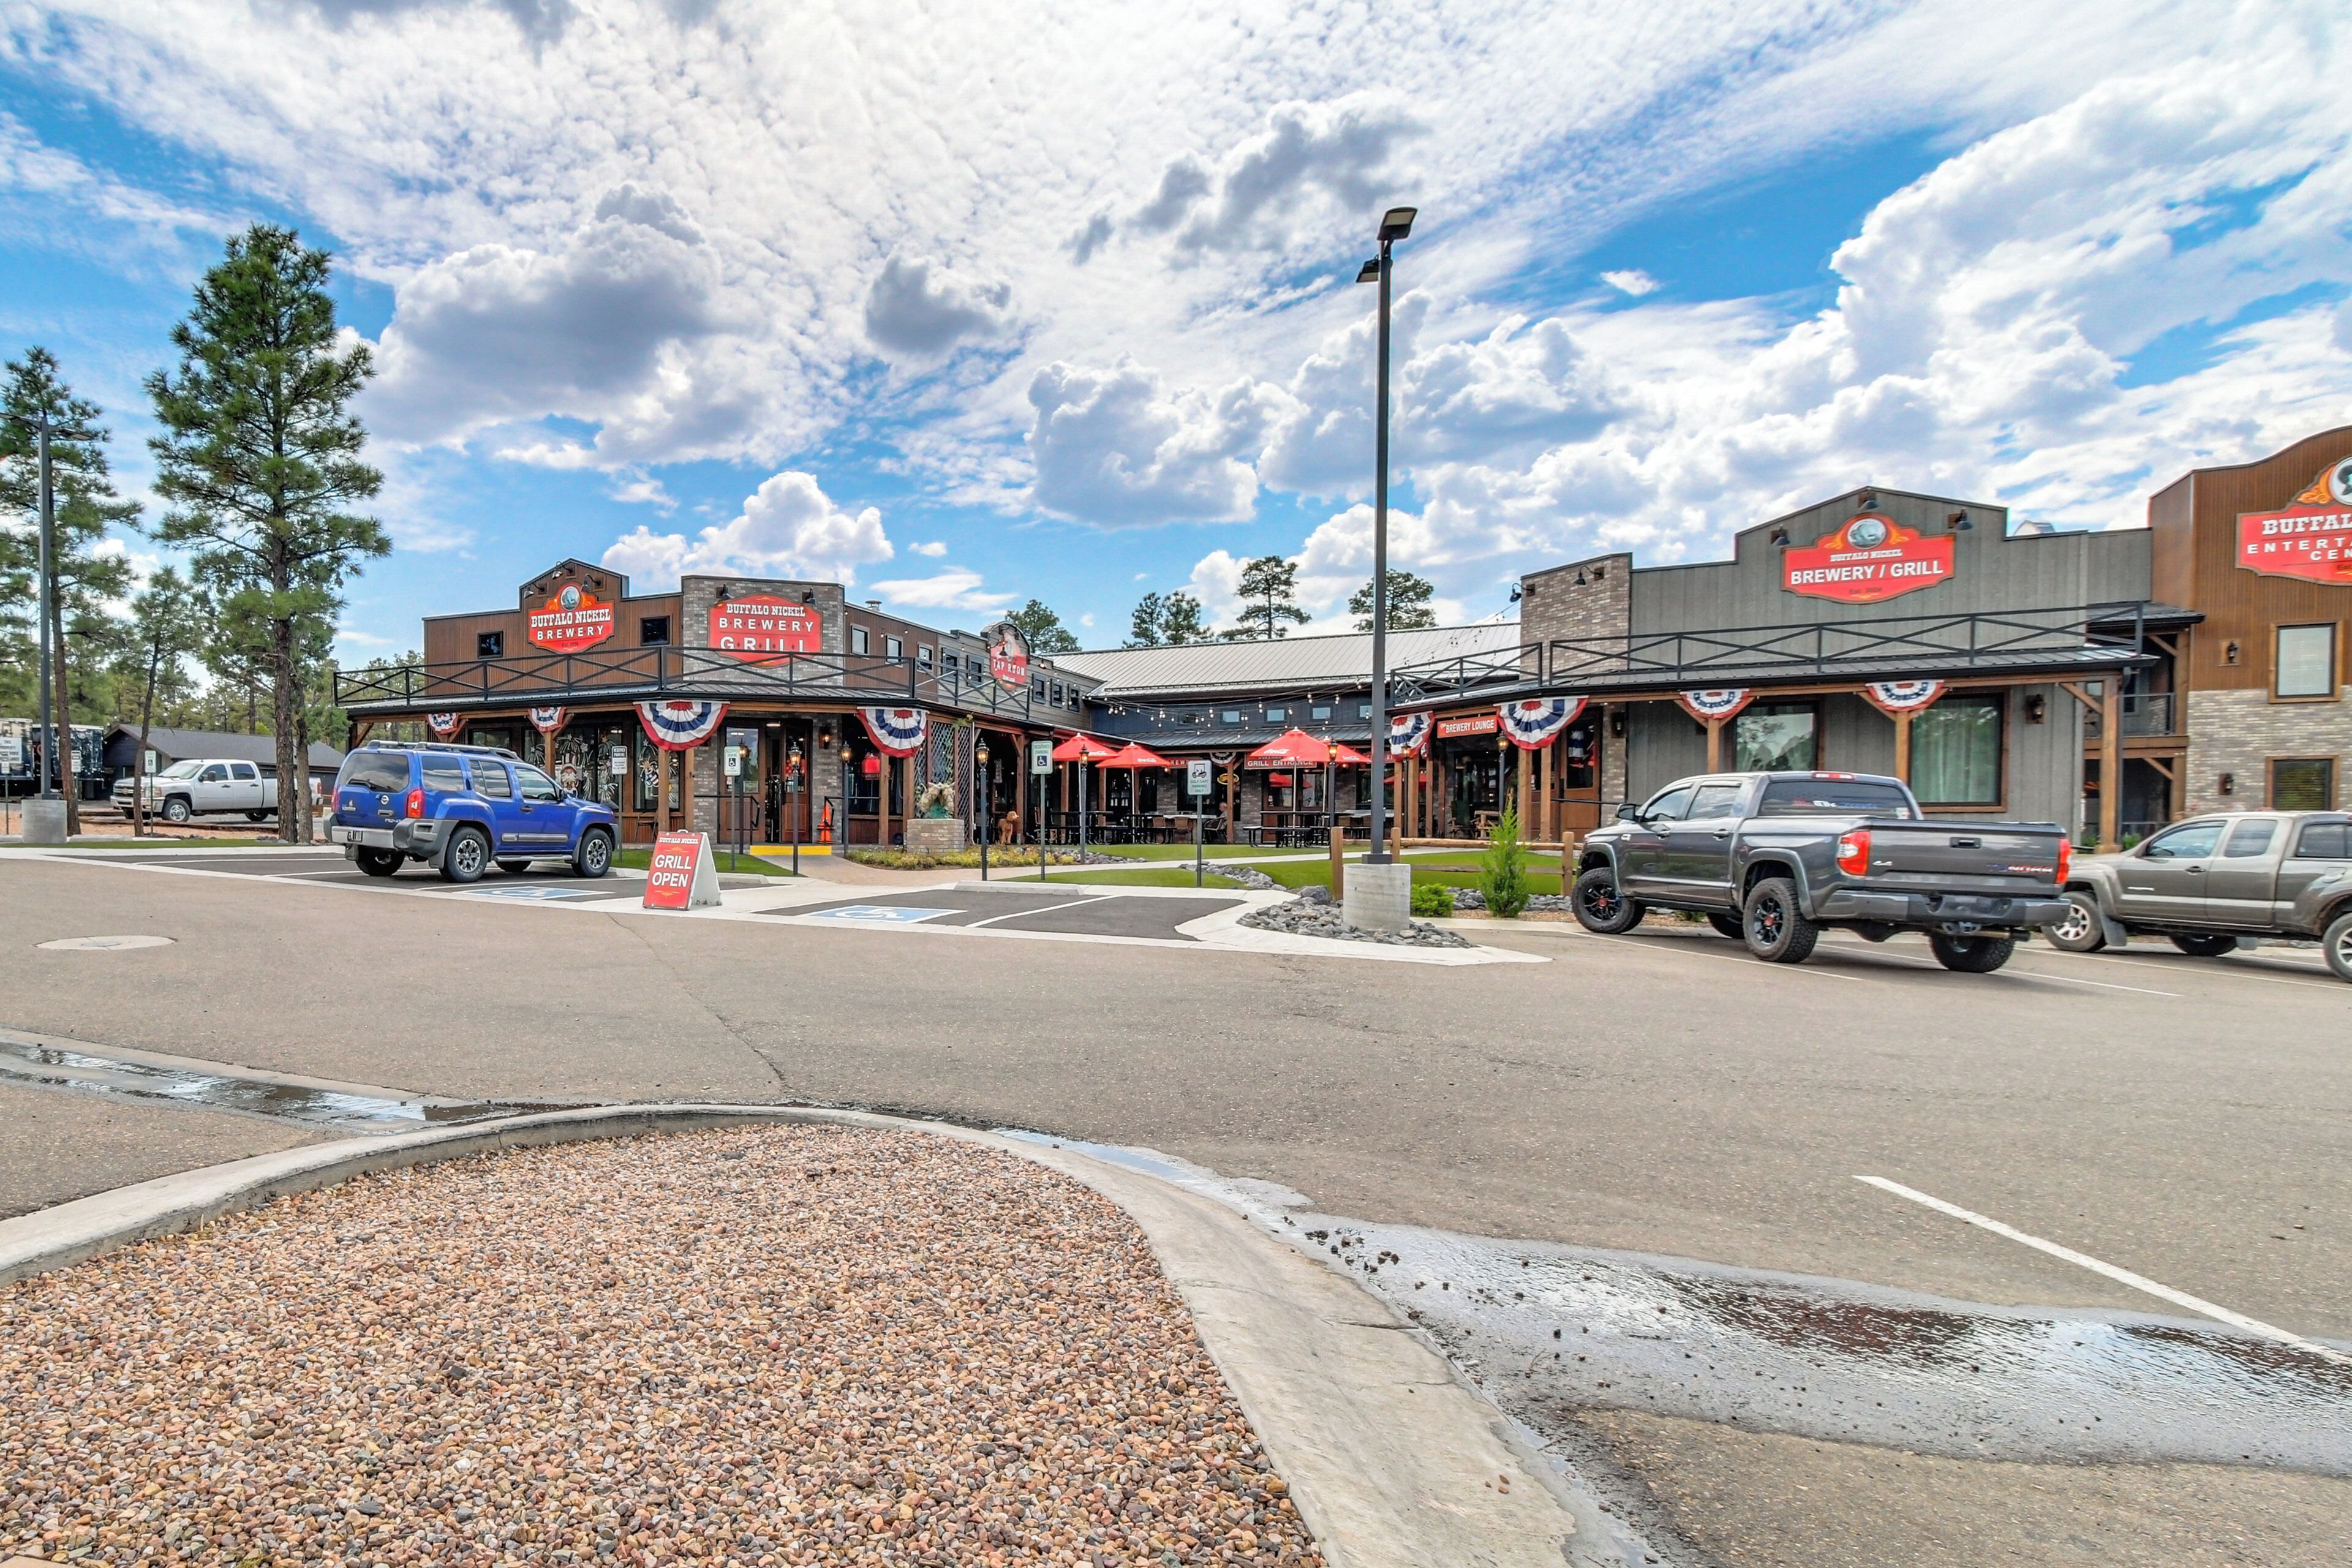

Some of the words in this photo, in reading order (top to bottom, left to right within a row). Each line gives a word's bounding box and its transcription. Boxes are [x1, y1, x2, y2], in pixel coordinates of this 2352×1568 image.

[2262, 513, 2352, 535] BUFFAL
[2247, 538, 2352, 554] ENTERT
[1830, 551, 1868, 562] BUFFALO
[1870, 549, 1902, 559] NICKEL
[1791, 565, 1875, 585] BREWERY
[1879, 565, 1885, 578] /
[1890, 560, 1943, 576] GRILL
[726, 603, 769, 616] BUFFALO
[771, 606, 805, 617] NICKEL
[531, 612, 572, 628] BUFFALO
[575, 609, 611, 624] NICKEL
[719, 617, 813, 632] BREWERY
[537, 625, 603, 640] BREWERY
[720, 636, 809, 652] GRILL
[993, 659, 1005, 670] TAP
[1008, 663, 1025, 676] ROOM
[1446, 722, 1471, 733] BREWERY
[1472, 719, 1494, 730] LOUNGE
[655, 854, 692, 869] GRILL
[652, 872, 688, 887] OPEN
